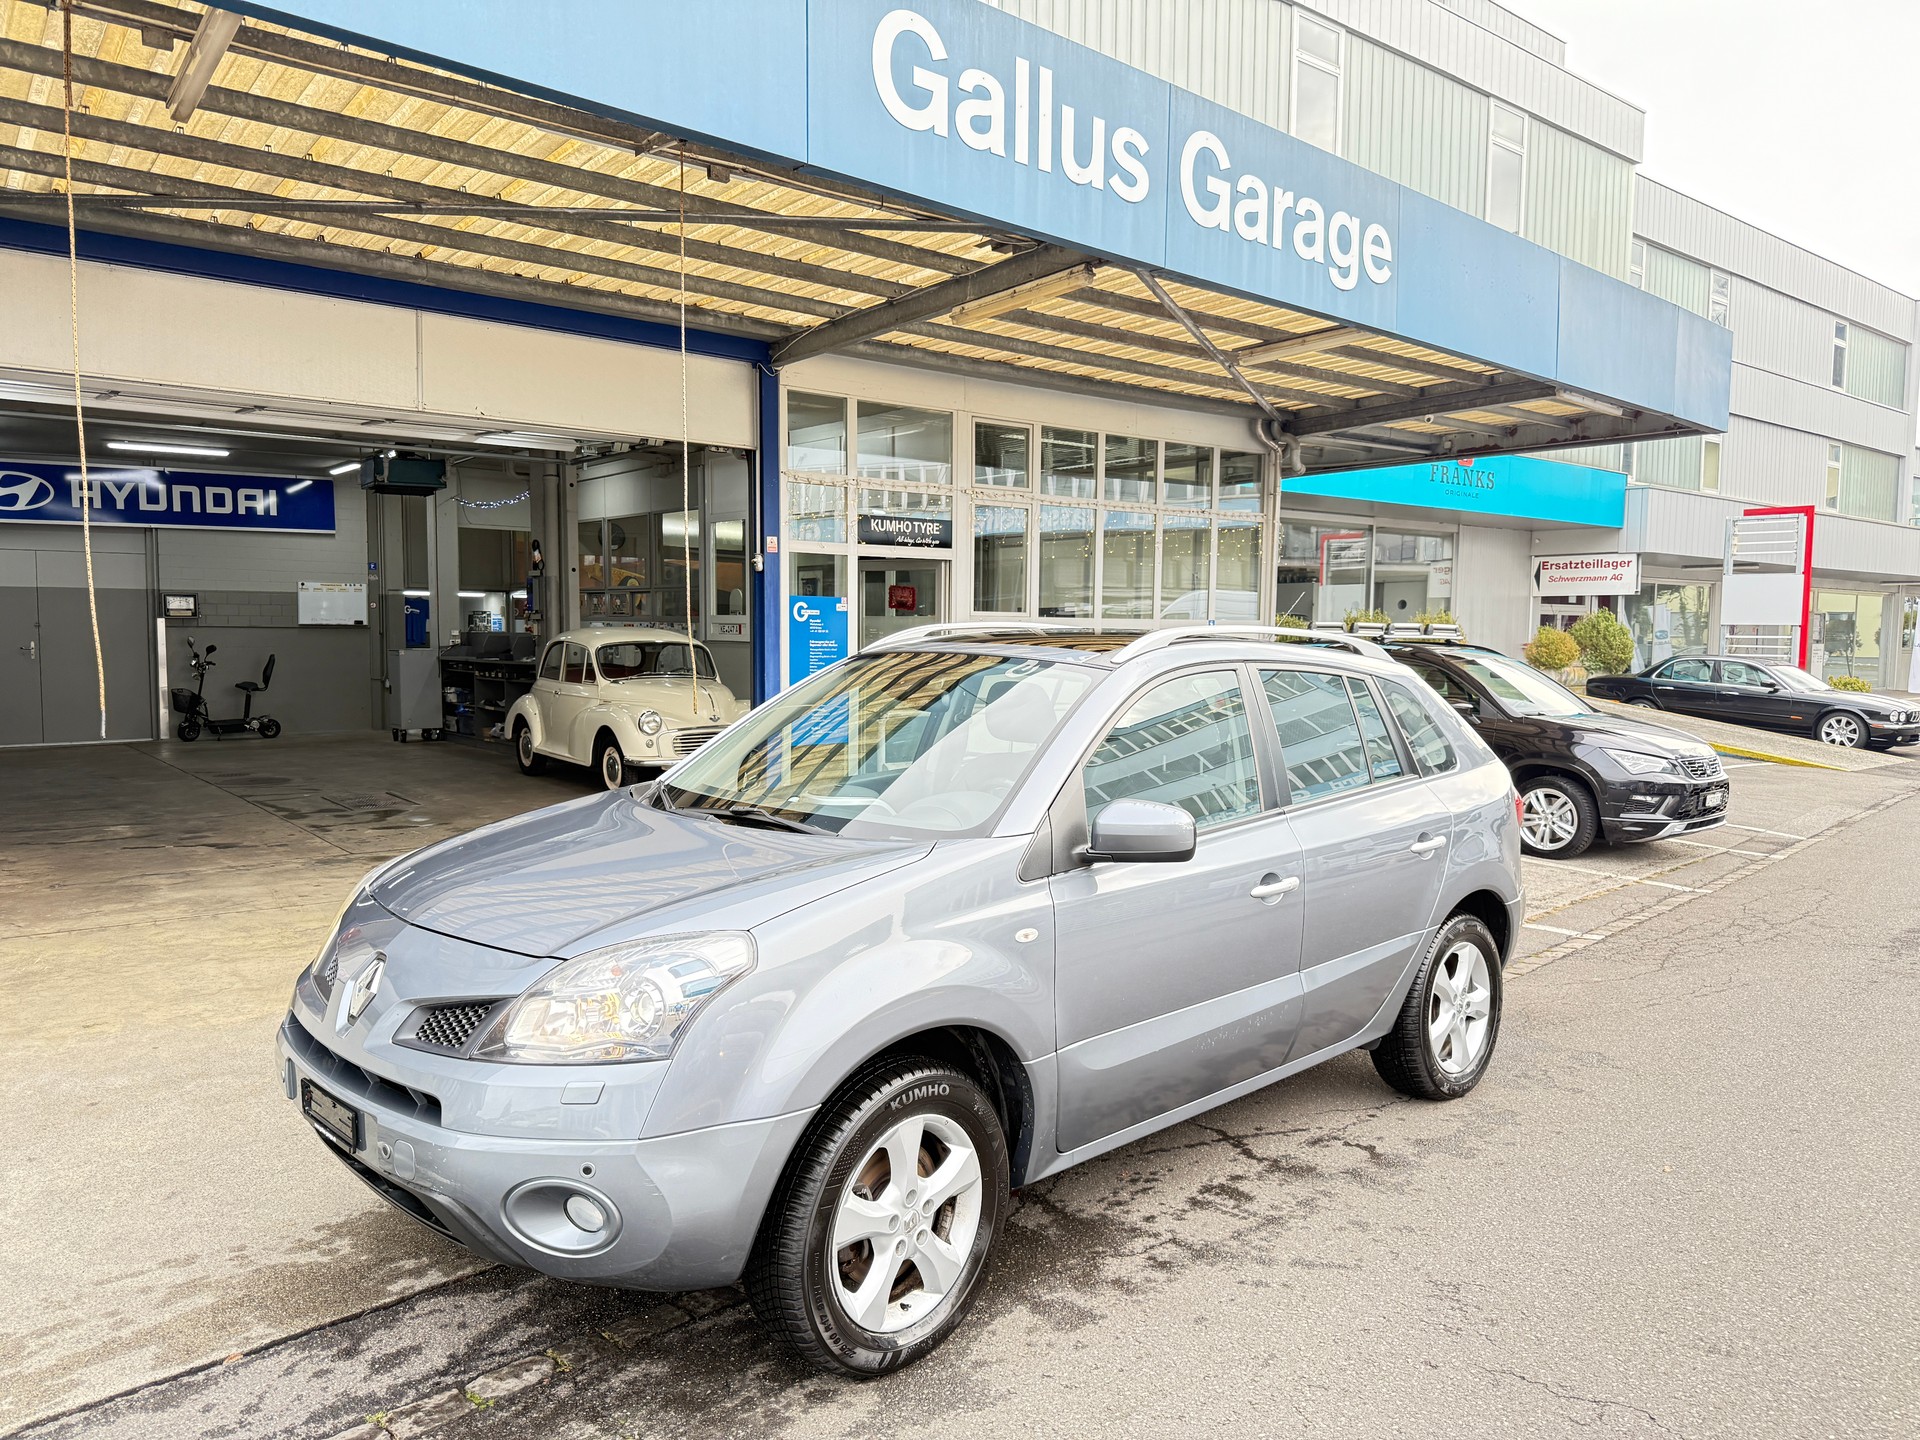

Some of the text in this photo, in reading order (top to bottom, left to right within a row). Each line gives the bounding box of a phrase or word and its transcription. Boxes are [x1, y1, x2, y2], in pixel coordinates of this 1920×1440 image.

[872, 9, 1393, 291] Gallus Garage
[1429, 463, 1495, 490] FRANKS
[70, 479, 278, 516] HYUNDAI
[1445, 489, 1479, 499] ORIGINALE
[871, 519, 940, 535] KUMHO TYRE
[1541, 558, 1633, 571] Ersatzteillager
[1548, 573, 1623, 584] Schwerzmann AG
[889, 1083, 951, 1111] KUMHO
[829, 1332, 857, 1359] 225/60
